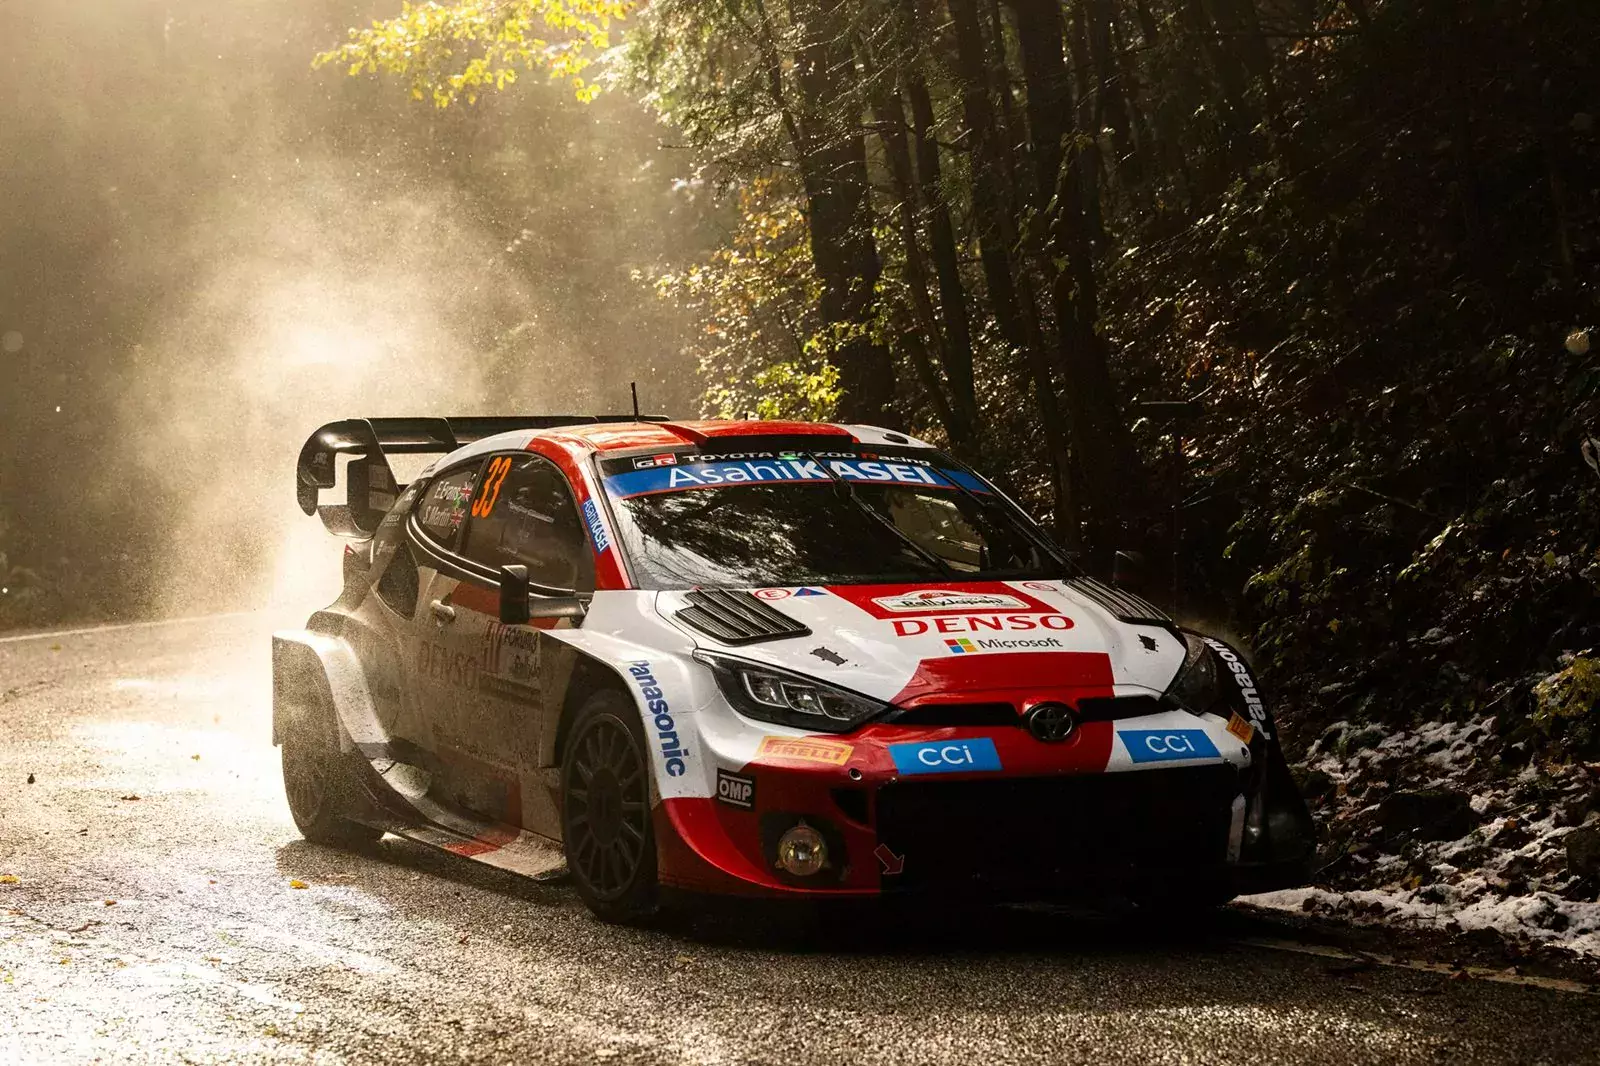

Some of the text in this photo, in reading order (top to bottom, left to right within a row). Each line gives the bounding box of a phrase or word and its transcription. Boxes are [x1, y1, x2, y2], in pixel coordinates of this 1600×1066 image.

[636, 457, 674, 468] GR
[682, 452, 773, 462] TOYOTA
[471, 457, 512, 518] 33
[891, 615, 1076, 637] DENSO
[978, 637, 1063, 650] Microsoft
[719, 778, 752, 801] OMP
